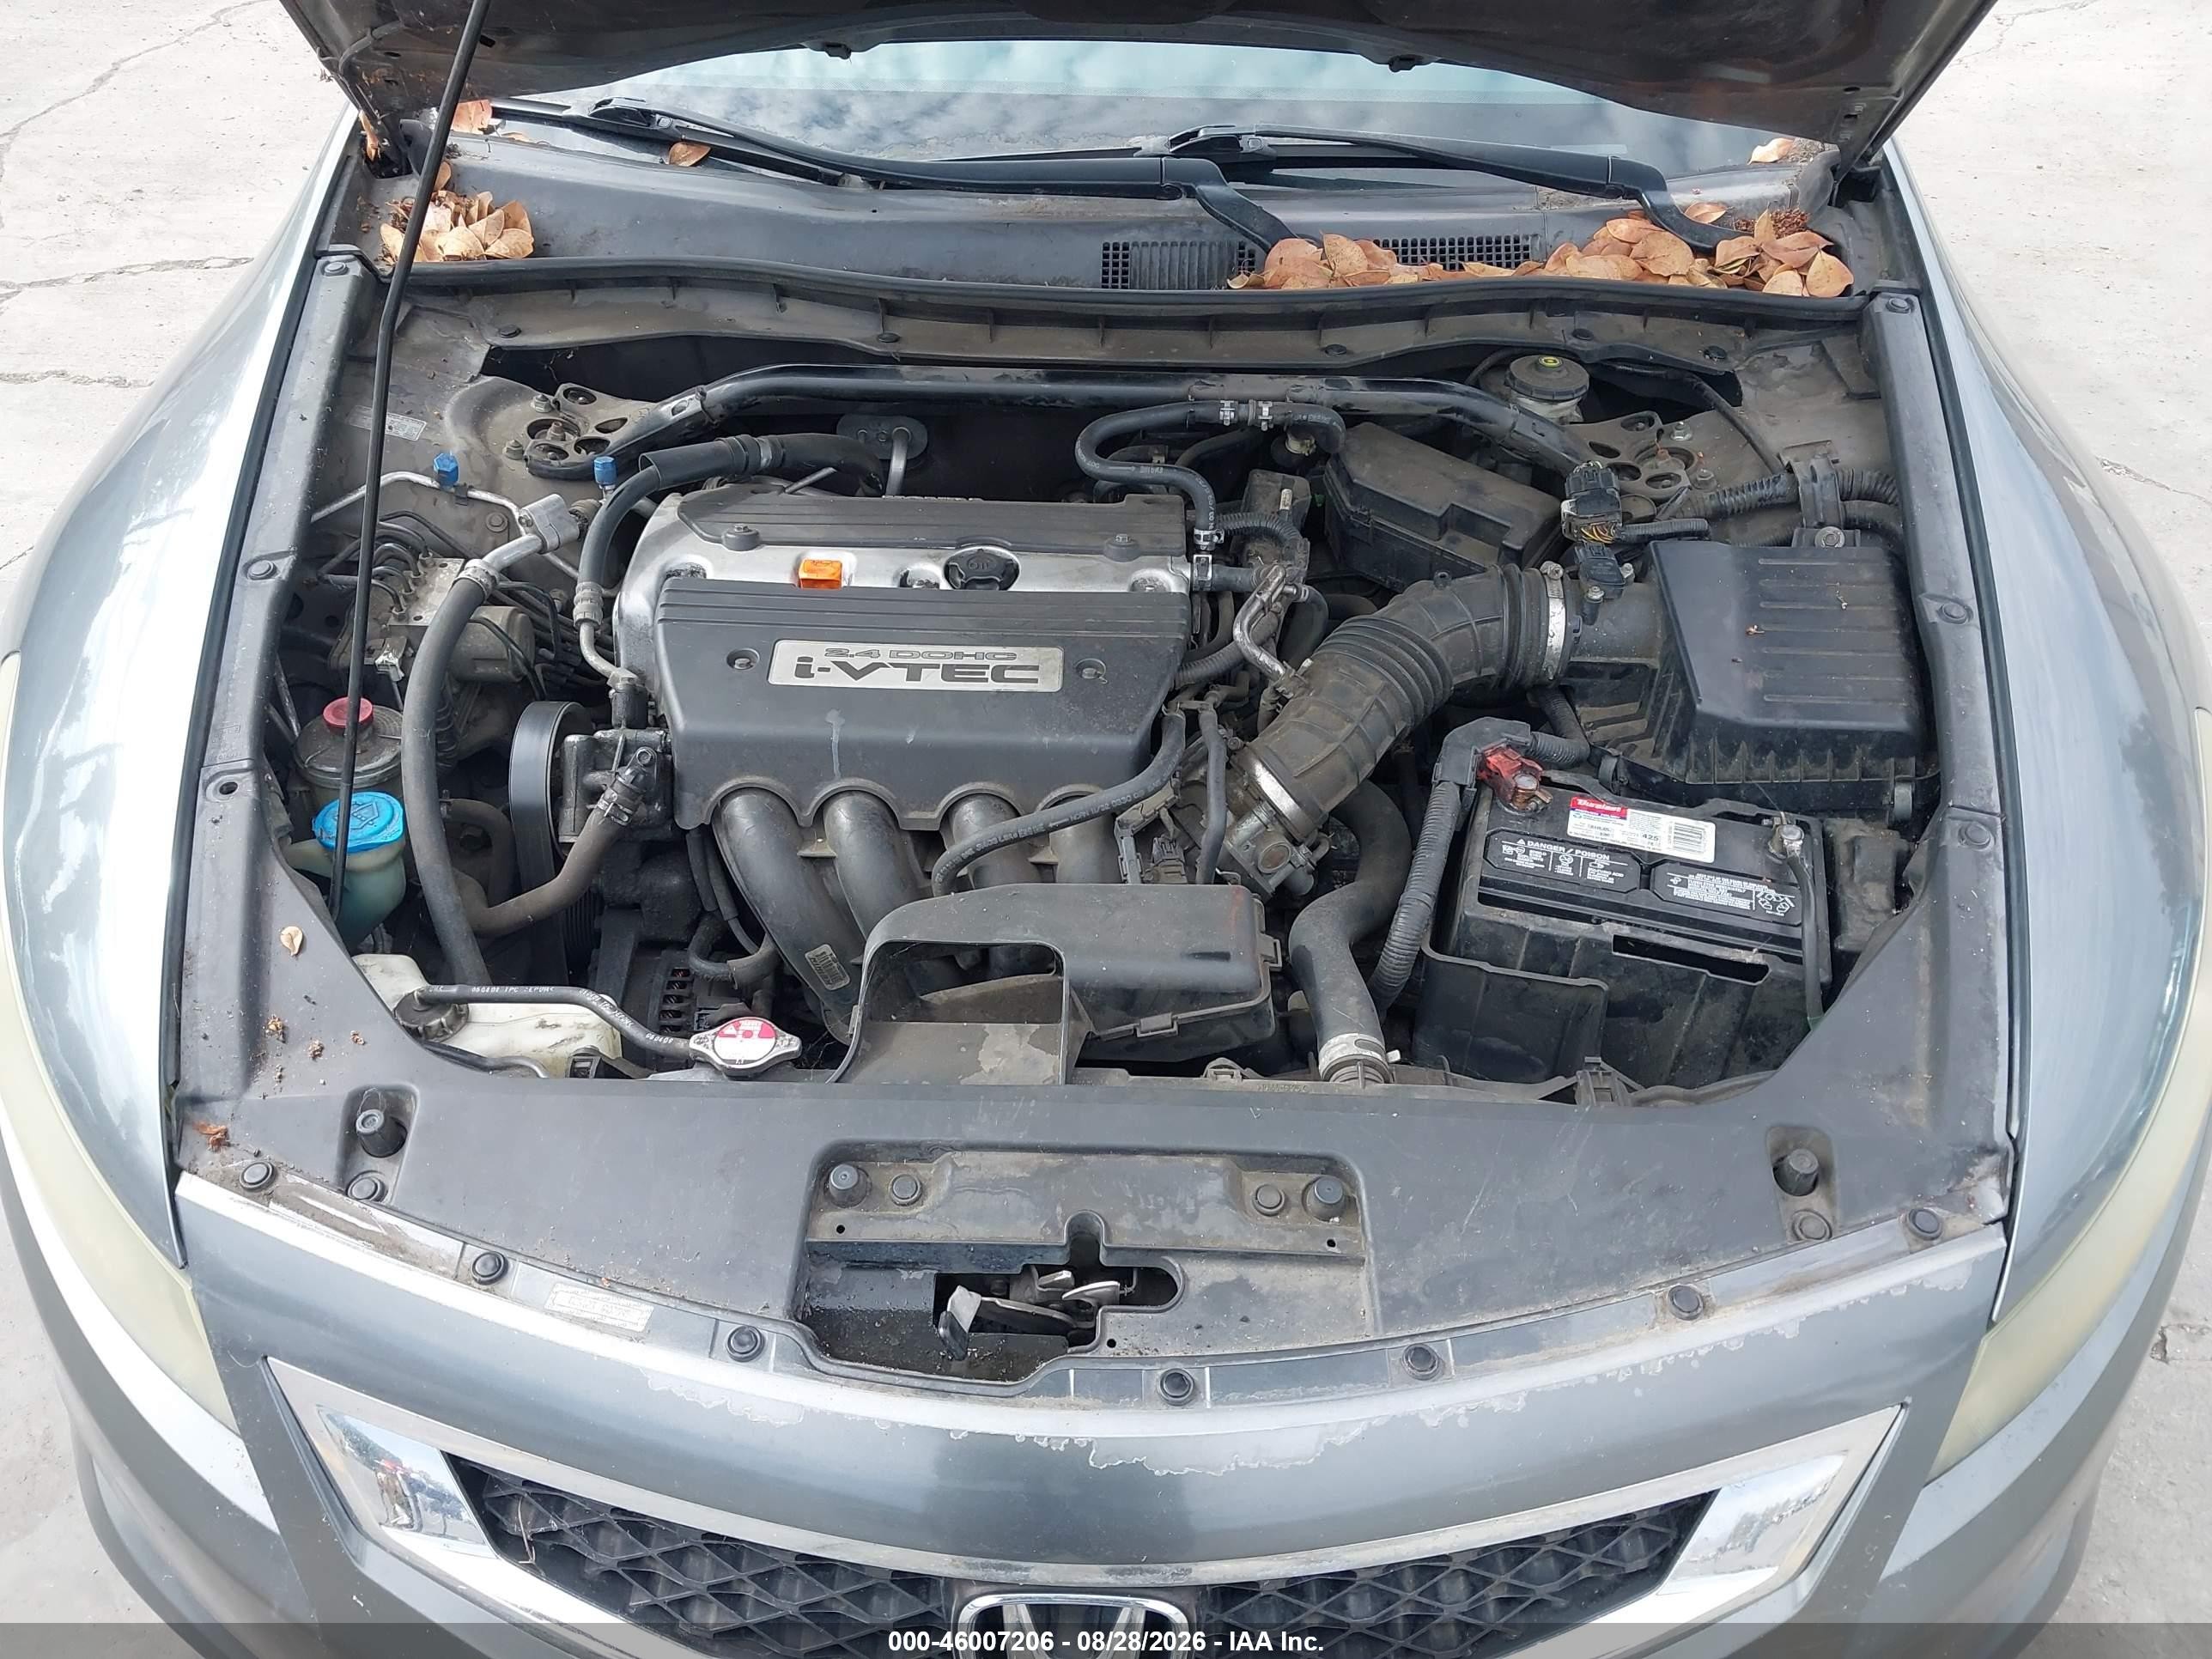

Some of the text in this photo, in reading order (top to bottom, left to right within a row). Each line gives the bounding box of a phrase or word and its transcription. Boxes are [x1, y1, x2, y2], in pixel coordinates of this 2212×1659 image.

[824, 648, 1018, 660] 2.4 DOHC
[794, 656, 1041, 684] i-VTEC
[1528, 841, 1566, 853] DANGER
[1575, 849, 1611, 860] POISON
